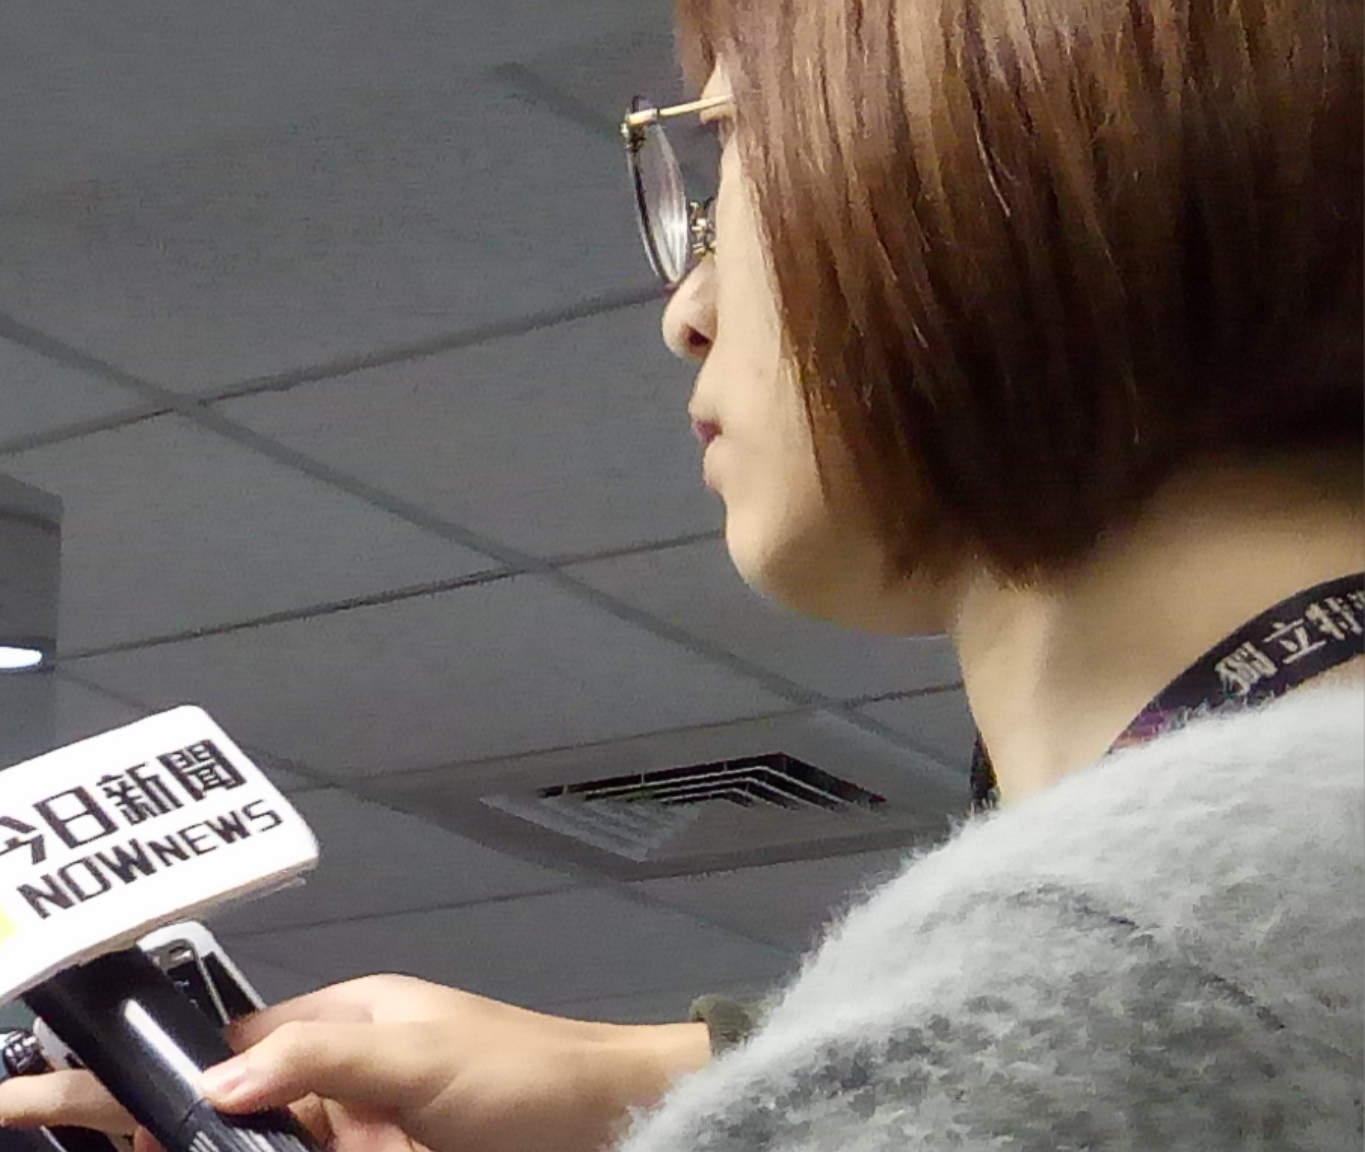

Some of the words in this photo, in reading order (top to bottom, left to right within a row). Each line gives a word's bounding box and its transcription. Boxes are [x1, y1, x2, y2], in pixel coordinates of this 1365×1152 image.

[1215, 591, 1365, 695] 獨立特
[16, 799, 283, 919] NOWNEWS
